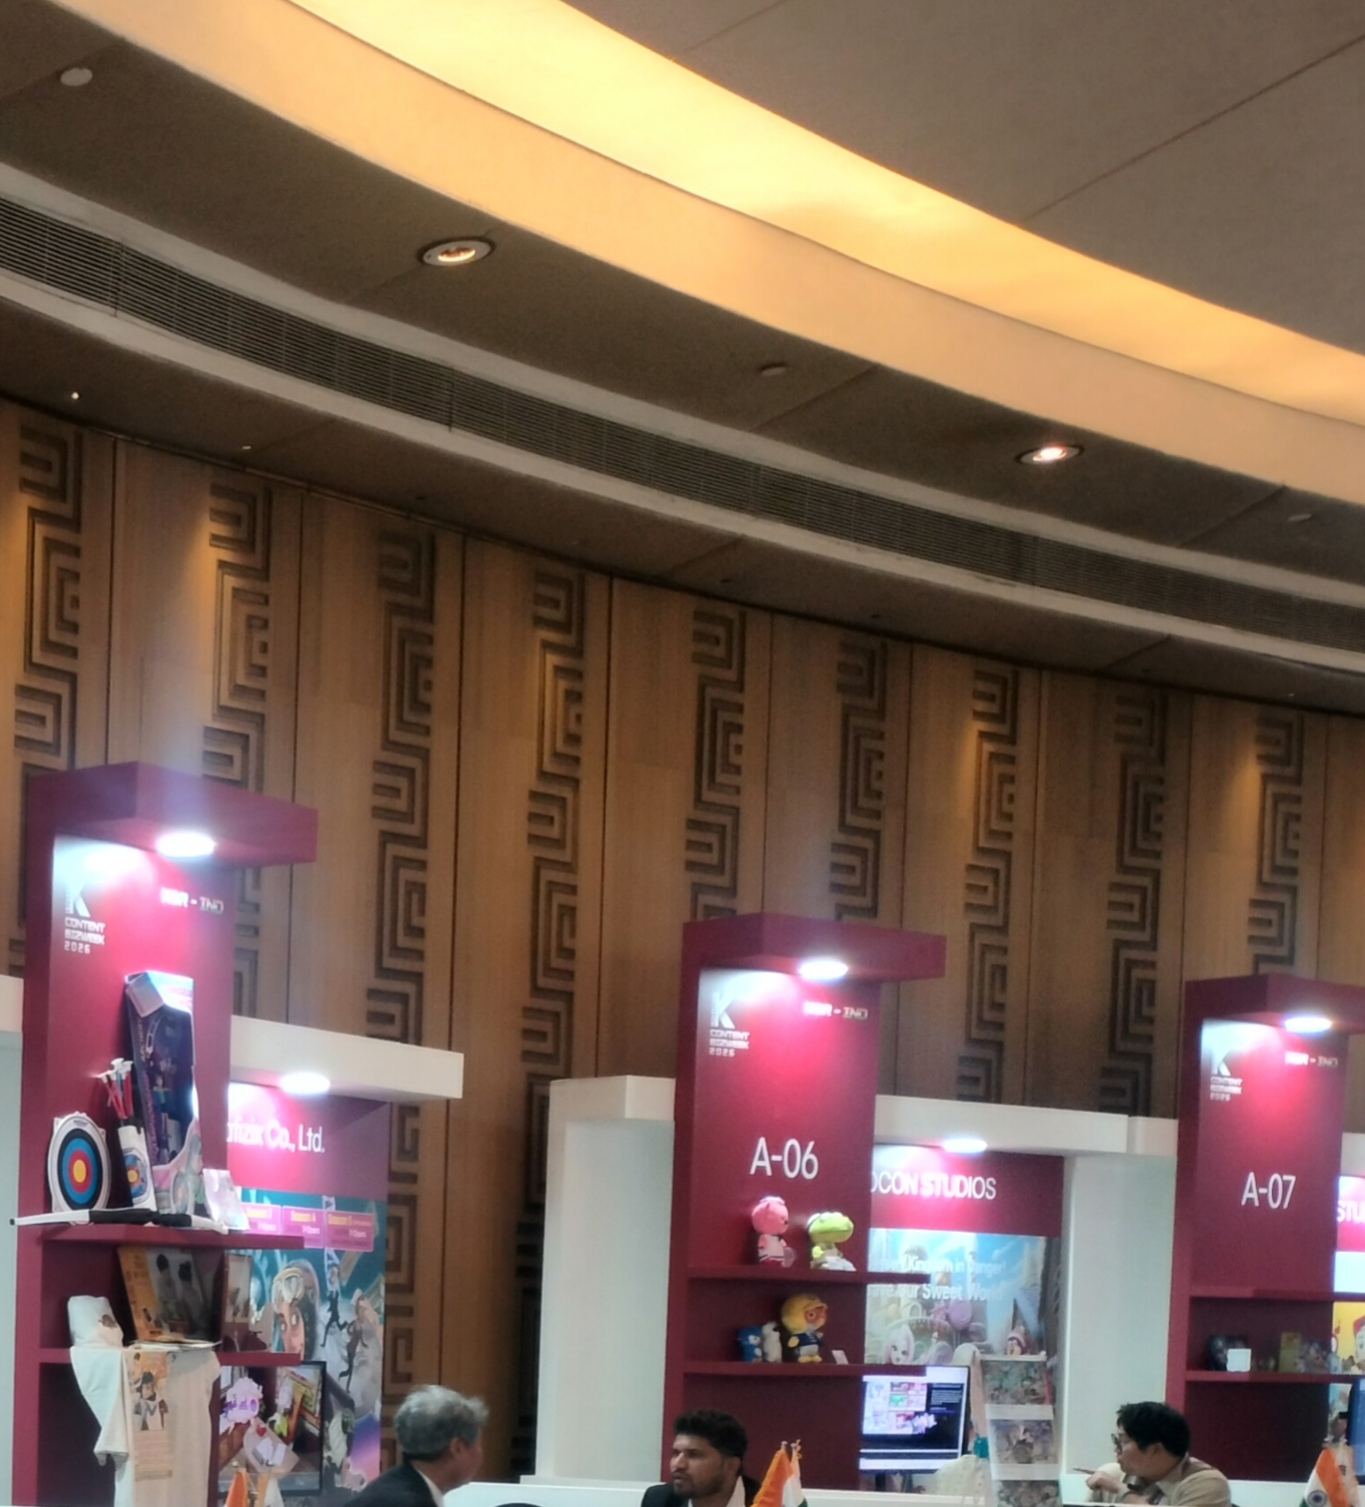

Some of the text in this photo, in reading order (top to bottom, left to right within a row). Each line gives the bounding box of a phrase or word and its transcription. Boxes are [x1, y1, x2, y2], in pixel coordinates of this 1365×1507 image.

[298, 1124, 326, 1153] Ltd.
[749, 1136, 819, 1180] A-06
[920, 1171, 997, 1200] STUDIOS
[1241, 1171, 1297, 1210] A-07
